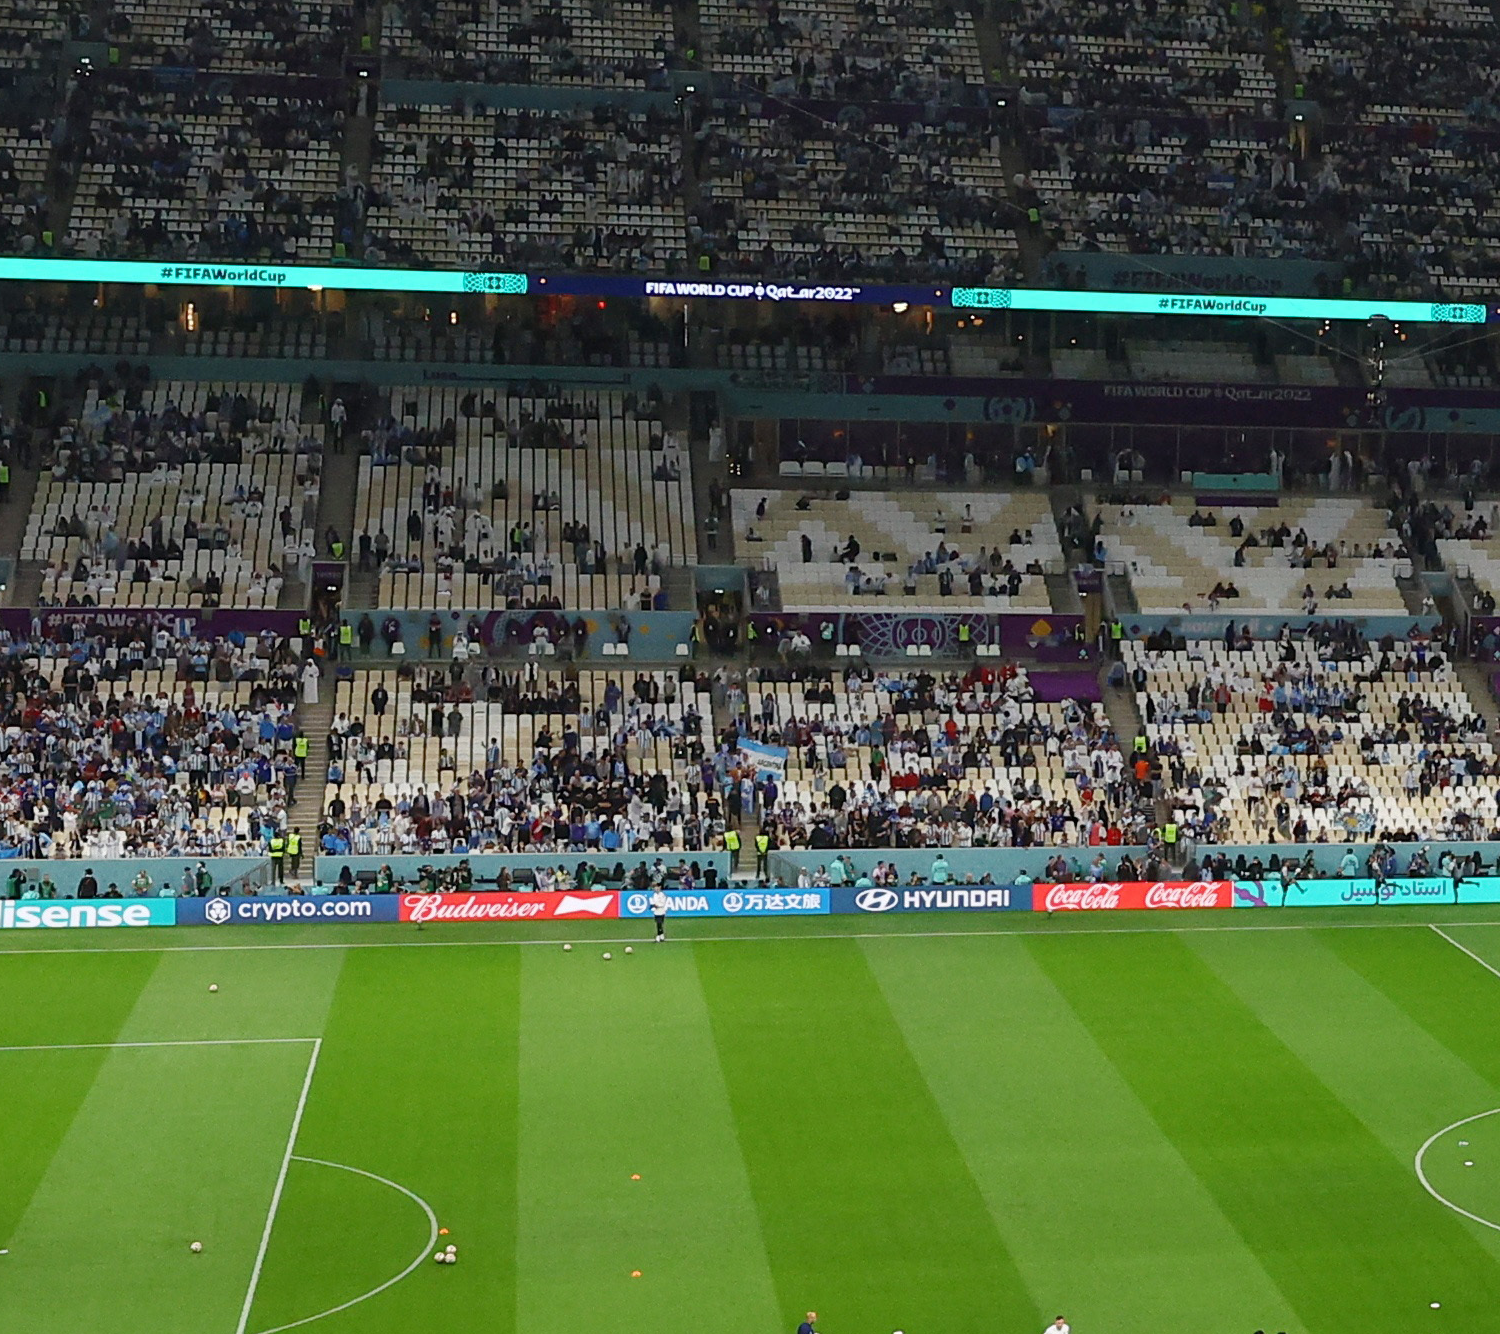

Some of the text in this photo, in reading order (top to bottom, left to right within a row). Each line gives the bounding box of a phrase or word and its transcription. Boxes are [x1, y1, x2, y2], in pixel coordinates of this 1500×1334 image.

[161, 267, 287, 285] #FIFAWorldCup
[645, 282, 754, 297] FIFA WORLD CUP
[1158, 298, 1267, 315] #FIFAWorldCup
[660, 896, 708, 912] ANDA
[744, 893, 822, 911] 万达文旅
[903, 889, 1010, 907] HYUNDAI
[1045, 883, 1124, 909] Coca-Cola
[1144, 881, 1224, 909] Coca-Cola
[238, 899, 371, 920] crypto.com
[403, 893, 546, 921] Budweiser
